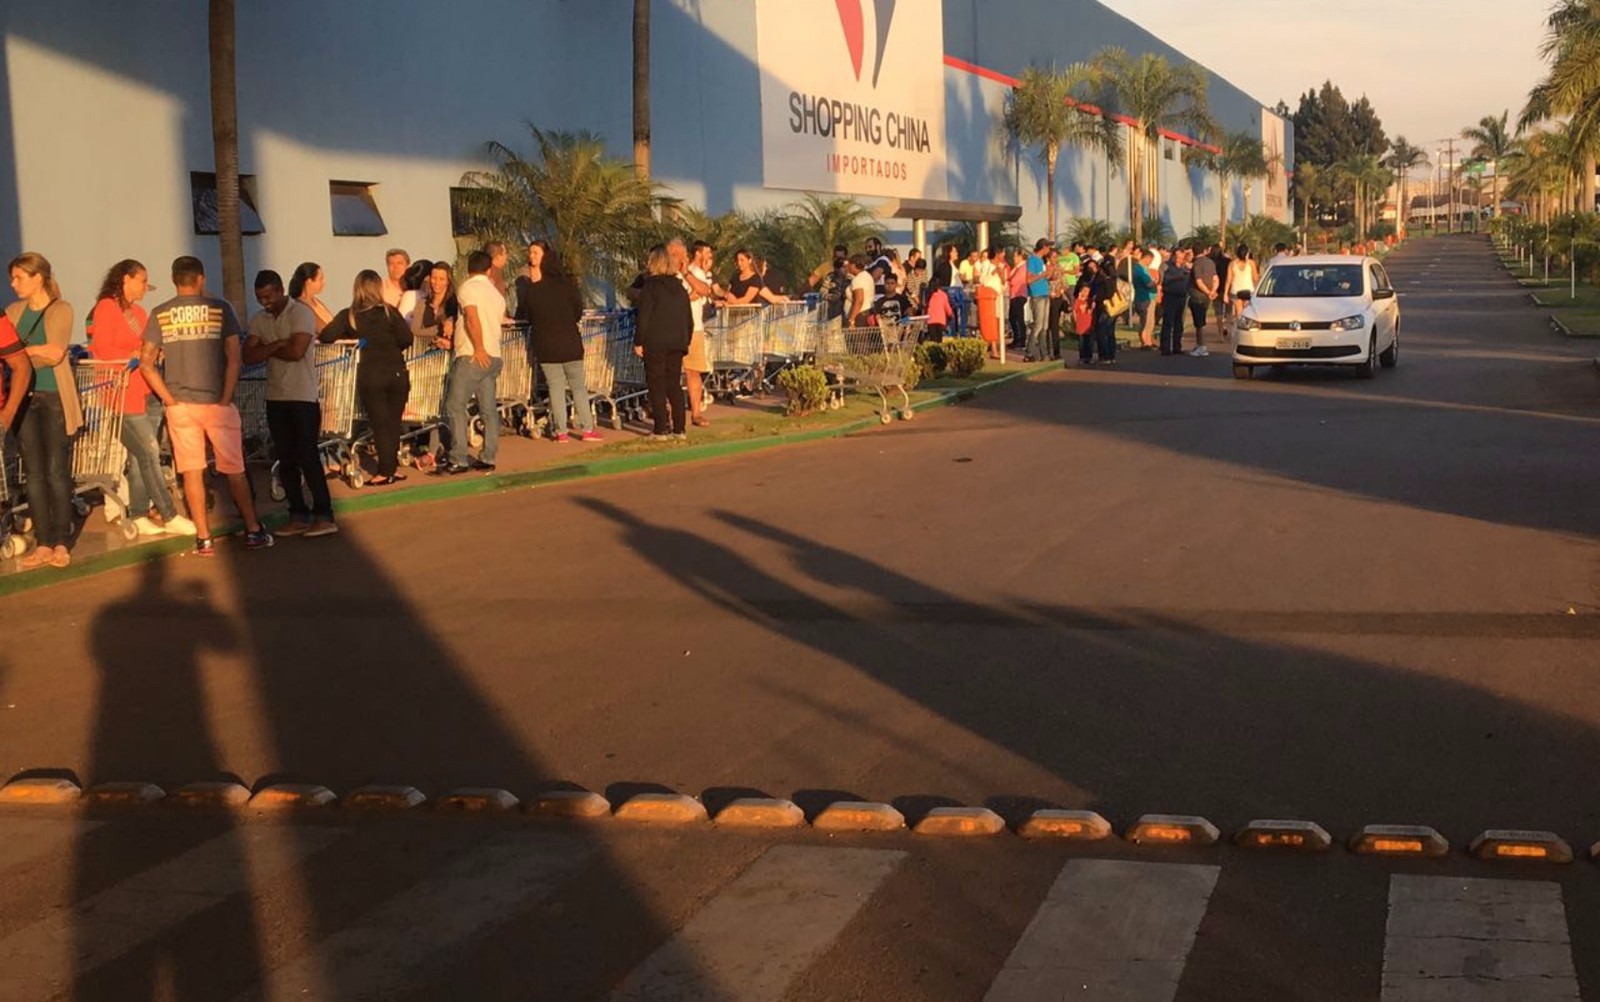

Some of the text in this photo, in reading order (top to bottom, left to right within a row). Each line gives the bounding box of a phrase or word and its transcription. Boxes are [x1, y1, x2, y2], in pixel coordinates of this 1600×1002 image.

[789, 91, 931, 153] SHOPPING CHINA
[826, 153, 907, 181] IMPORTADOS
[169, 304, 209, 324] COBRA
